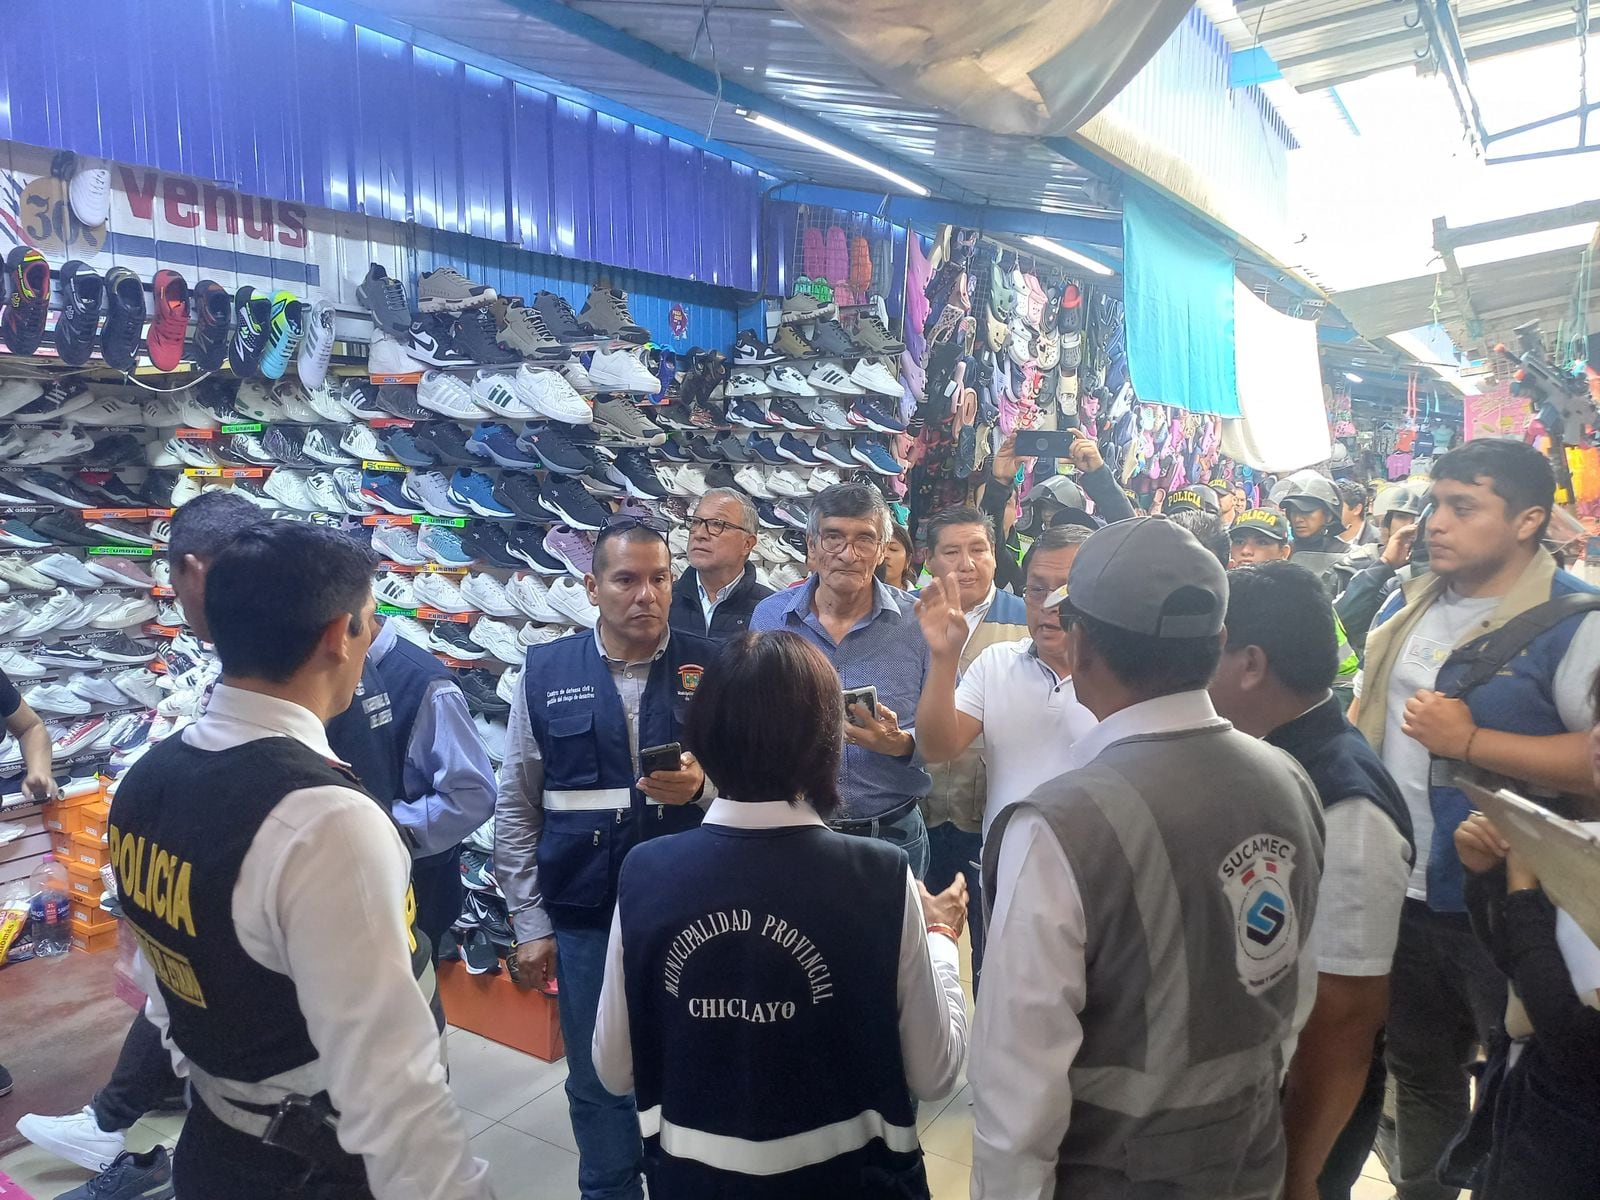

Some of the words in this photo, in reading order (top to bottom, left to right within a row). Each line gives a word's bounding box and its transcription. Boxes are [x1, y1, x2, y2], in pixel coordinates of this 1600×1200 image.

[1168, 490, 1201, 508] POLICIA
[1237, 510, 1277, 527] POLICIA
[1222, 838, 1290, 878] SUCAMEC
[664, 909, 751, 998] MUNICIPALIDAD
[761, 914, 834, 1005] PROVINCIAL
[688, 997, 796, 1023] CHICLAYO
